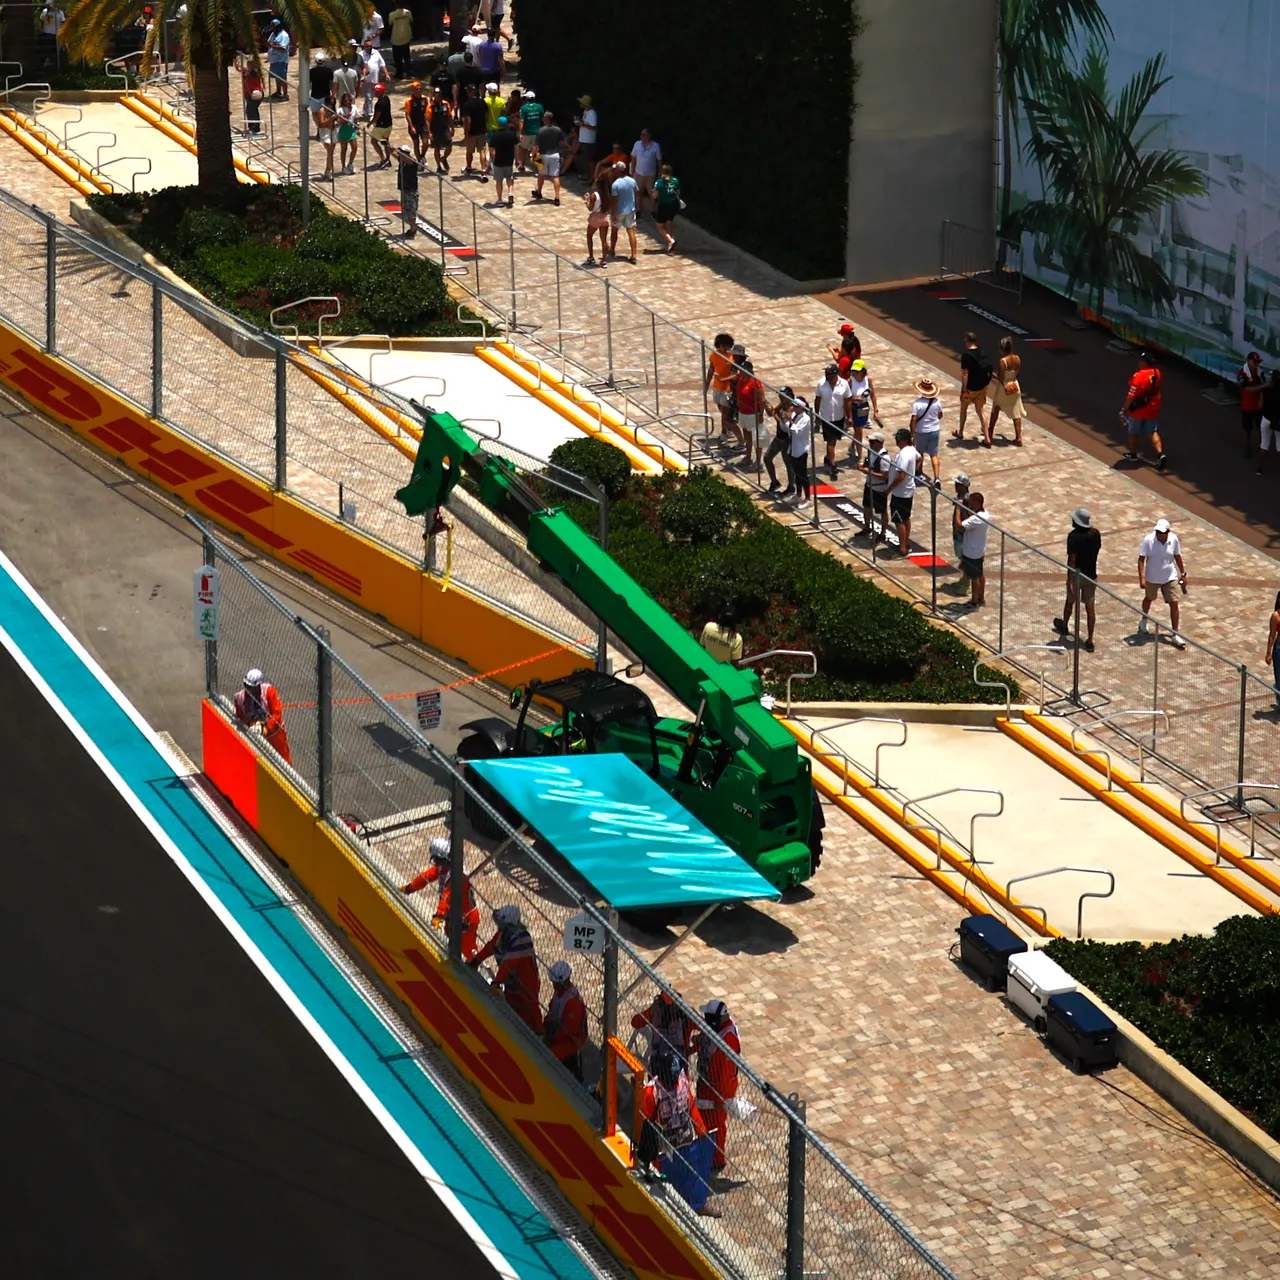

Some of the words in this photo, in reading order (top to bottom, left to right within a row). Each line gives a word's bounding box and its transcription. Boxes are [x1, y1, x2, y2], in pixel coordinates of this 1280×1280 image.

[7, 347, 293, 551] DHL
[573, 926, 596, 938] MP
[573, 938, 594, 950] 8.7
